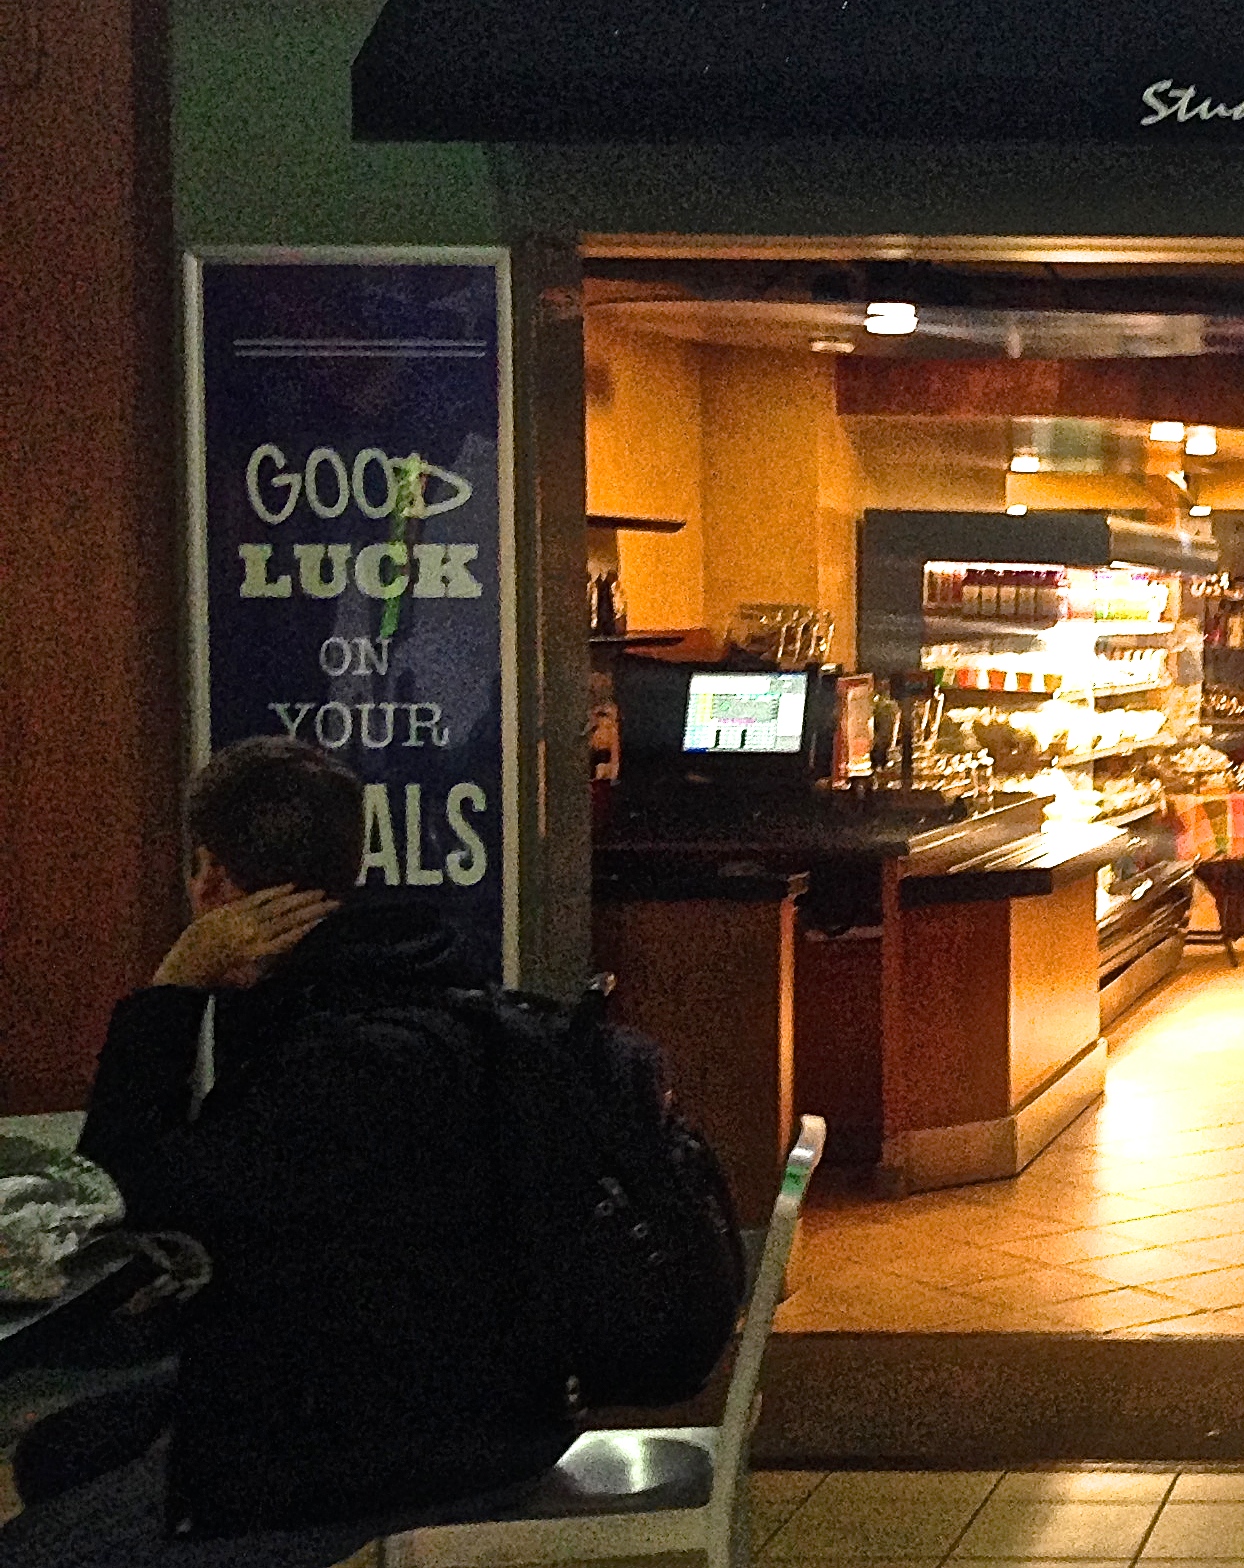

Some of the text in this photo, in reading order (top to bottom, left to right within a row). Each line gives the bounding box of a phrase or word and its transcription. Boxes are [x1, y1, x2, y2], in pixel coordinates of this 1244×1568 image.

[245, 442, 473, 526] GOOD
[237, 542, 484, 599] LUCK
[318, 636, 393, 677] ON
[267, 701, 451, 750] YOUR
[354, 782, 488, 887] ALS
